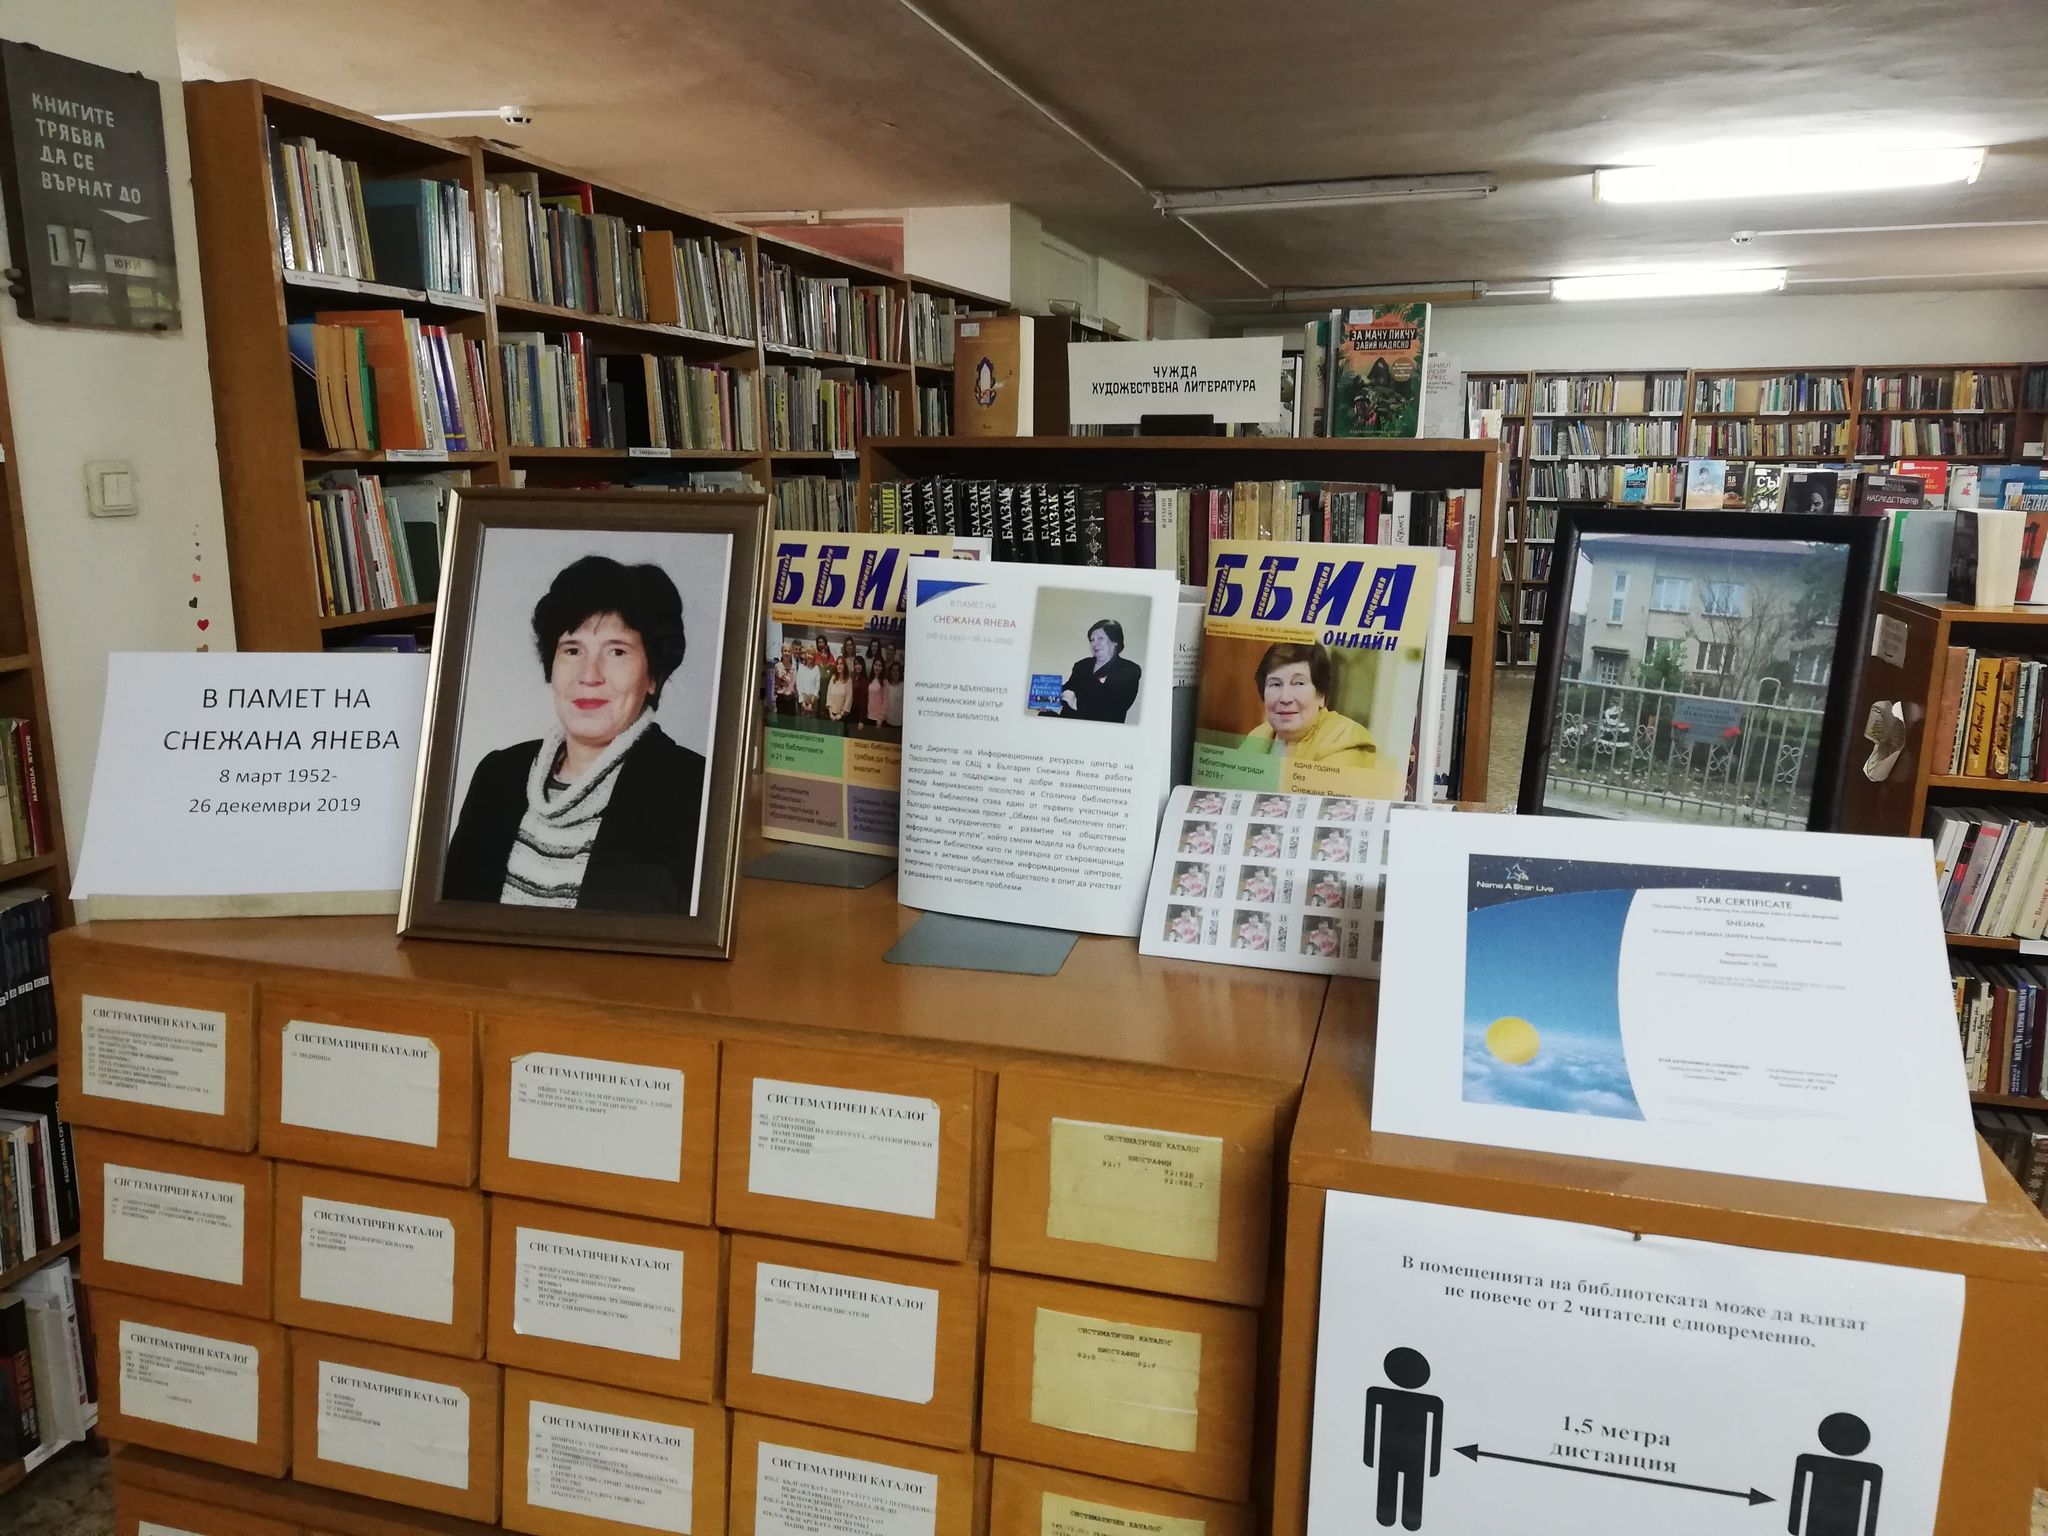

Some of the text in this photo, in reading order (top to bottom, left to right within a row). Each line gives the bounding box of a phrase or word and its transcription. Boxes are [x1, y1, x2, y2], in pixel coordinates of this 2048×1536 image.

[32, 93, 114, 128] КНИГИТЕ
[35, 118, 105, 149] ТРЯБВА
[40, 146, 94, 171] ДА СЕ
[41, 171, 141, 204] ВЪРНАТ ДО
[114, 253, 142, 269] ЮНИ
[1352, 331, 1362, 340] ЗА
[1365, 331, 1388, 340] МАЧУ
[1379, 340, 1409, 349] НАДЯСНО
[1153, 366, 1197, 378] ЧУЖДА
[1092, 380, 1256, 395] ХУДОЖЕСТВЕНА ЛИТЕРАТУРА
[980, 485, 994, 538] БАЛЗАК
[999, 488, 1014, 540] БАЛЗАК
[1020, 488, 1034, 541] БАЛЗАК
[1048, 494, 1061, 547] БАЛЗАК
[1064, 490, 1077, 543] БАЛЗАК
[1308, 565, 1330, 622] ИНФОРМАЦИЯ
[1365, 577, 1386, 625] АСОЦИАЦИЯ
[934, 615, 1016, 628] СНЕЖАНА ЯНЕВА
[1324, 631, 1398, 651] ОНЛАЙН
[203, 688, 371, 708] В ПАМЕТ НА
[915, 681, 951, 690] ИНИЦИАТОР
[959, 685, 1008, 695] ВДЪХНОВИТЕЛ
[926, 697, 976, 706] АМЕРИКАНСКИЯ
[956, 713, 999, 722] БИБЛИОТЕКА
[163, 730, 399, 750] СНЕЖАНА ЯНЕВА
[909, 754, 947, 765] Посолството
[965, 760, 982, 769] САЩ
[997, 763, 1031, 772] България
[1036, 767, 1070, 776] Снежана
[1076, 770, 1099, 779] Янева
[1105, 773, 1133, 782] работи
[910, 743, 922, 751] Като
[927, 745, 959, 754] Директор
[978, 750, 1044, 762] Информационния
[1049, 756, 1084, 766] ресурсен
[1090, 761, 1118, 769] център
[1294, 761, 1340, 774] една година
[219, 769, 338, 785] 8 март 1952-
[1293, 773, 1305, 782] без
[189, 798, 360, 815] 26 декември 2019
[982, 809, 1006, 819] проект
[1053, 816, 1103, 828] библиотечен
[1477, 880, 1503, 890] Name
[1513, 883, 1535, 891] Star
[1696, 896, 1792, 910] STAR CERTIFICATE
[1725, 919, 1765, 928] SNEJANA
[93, 1008, 216, 1032] СИСТЕМАТИЧЕН КАТАЛОГ
[294, 1033, 430, 1059] СИСТЕМАТИЧЕН КАТАЛОГ
[525, 1064, 673, 1092] СИСТЕМАТИЧЕН КАТАЛОГ
[767, 1093, 929, 1122] СИСТЕМАТИЧЕН КАТАЛОГ
[1104, 1134, 1201, 1154] СИСТЕМАТИЧЕН КАТАЛОГ
[114, 1177, 233, 1203] СИСТЕМАТИЧЕН КАТАЛОГ
[314, 1210, 395, 1231] СИСТЕМАТИЧЕН
[398, 1222, 445, 1239] КАТАЛОГ
[529, 1242, 673, 1271] СИСТЕМАТИЧЕН КАТАЛОГ
[770, 1277, 927, 1310] СИСТЕМАТИЧЕН КАТАЛОГ
[1402, 1256, 1868, 1333] В помещенията на библиотеката може да влизат
[1444, 1285, 1816, 1349] не повече от 2 читатели едновременно.
[130, 1333, 248, 1364] СИСТЕМАТИЧЕН КАТАЛОГ
[330, 1375, 459, 1407] СИСТЕМАТИЧЕН КАТАЛОГ
[542, 1415, 683, 1448] СИСТЕМАТИЧЕН КАТАЛОГ
[1563, 1415, 1671, 1448] 1,5 метра
[1550, 1442, 1677, 1475] дистанция
[771, 1457, 927, 1495] СИСТЕМАТИЧЕН КАТАЛОГ
